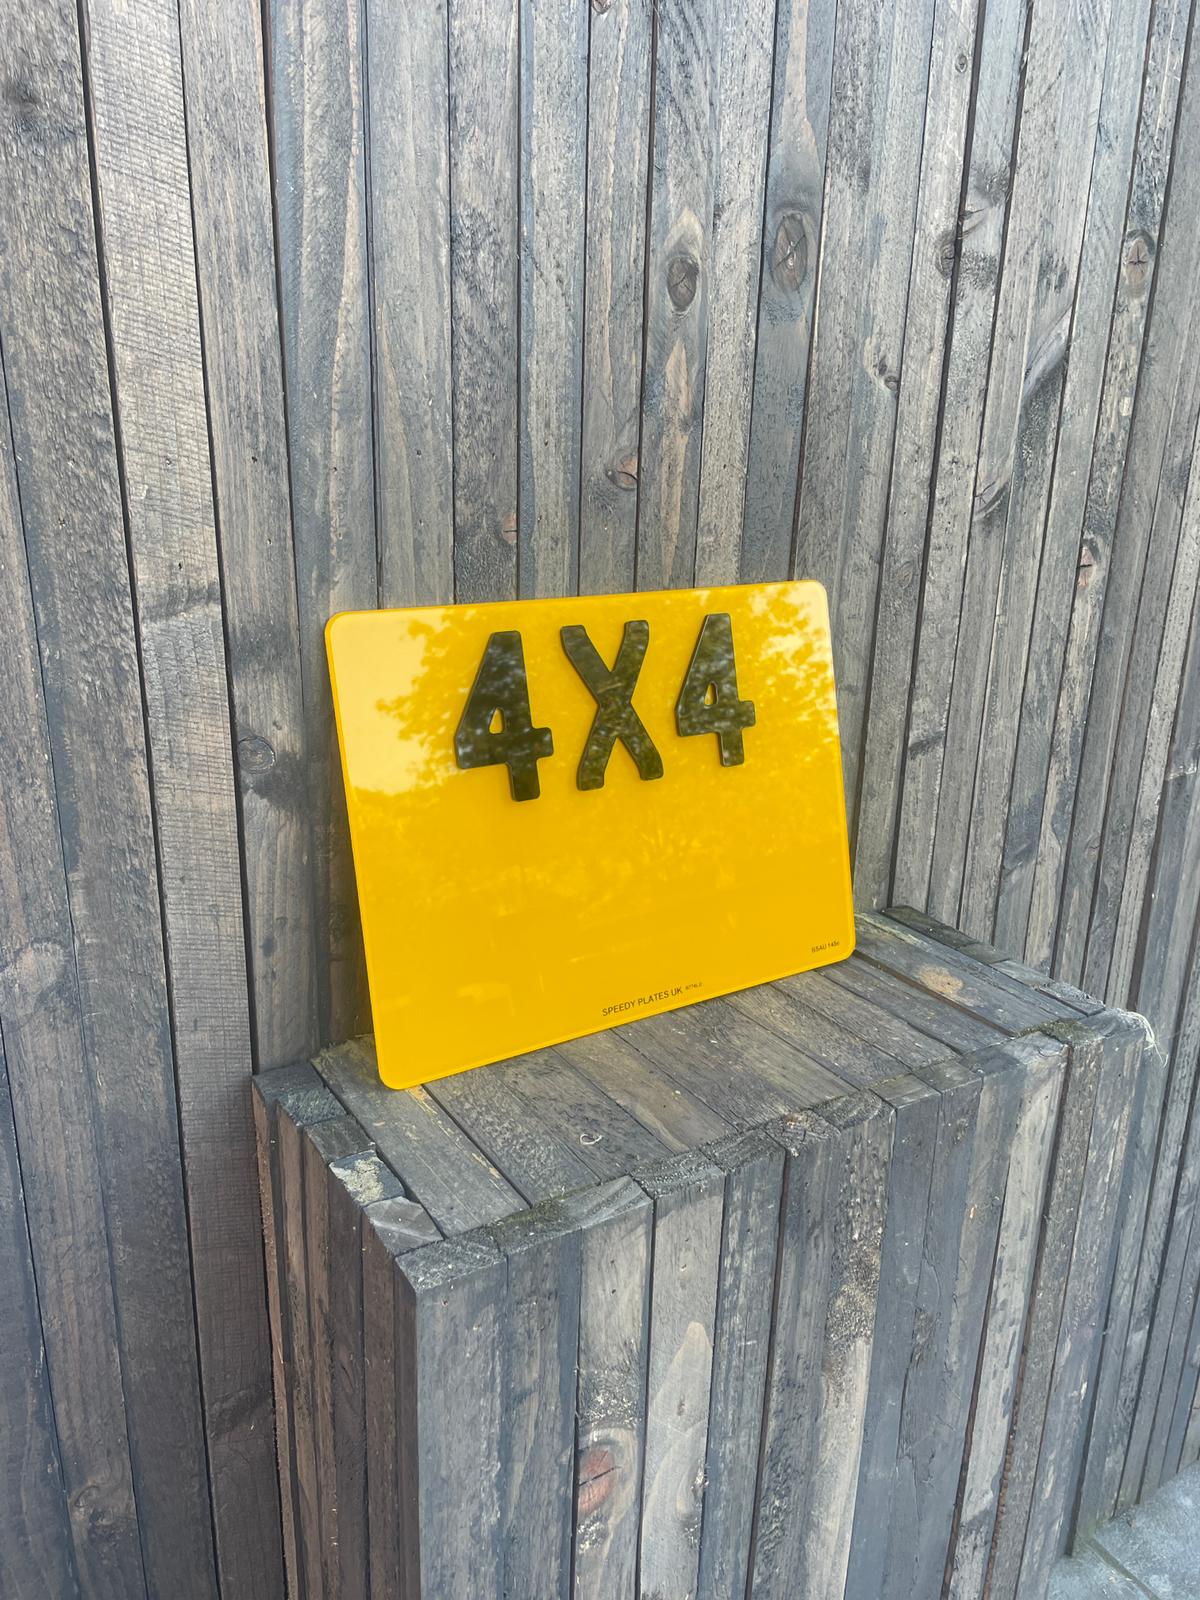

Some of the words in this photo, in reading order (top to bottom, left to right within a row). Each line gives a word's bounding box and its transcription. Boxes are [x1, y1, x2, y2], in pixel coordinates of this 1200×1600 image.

[602, 1000, 636, 1016] SPEEDY
[638, 991, 669, 1006] PLATES
[671, 986, 683, 996] UK
